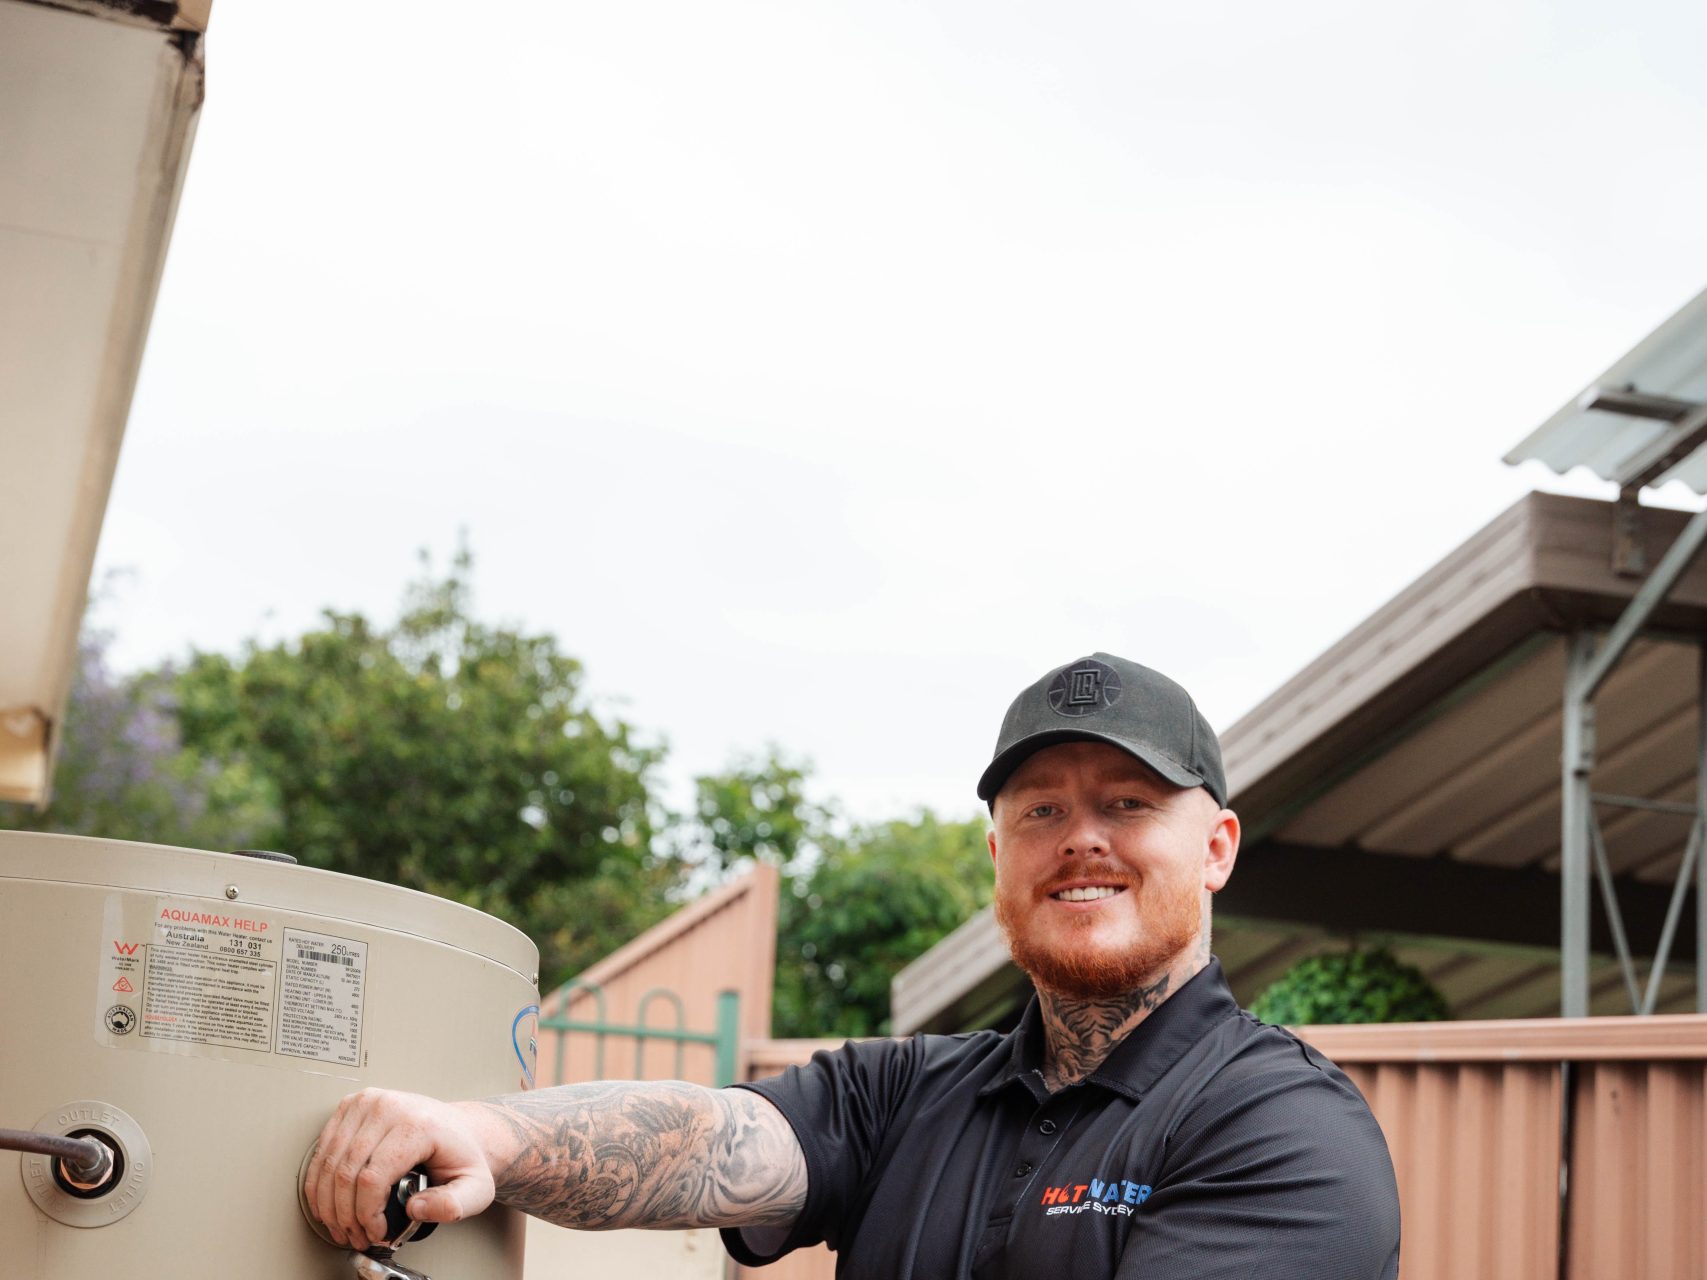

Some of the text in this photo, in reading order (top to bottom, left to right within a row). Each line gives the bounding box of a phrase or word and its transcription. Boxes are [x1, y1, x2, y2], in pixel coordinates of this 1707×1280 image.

[160, 908, 268, 932] AQUAMAX HELP
[174, 924, 196, 932] problems
[166, 931, 262, 950] Australia 131 031
[182, 940, 208, 950] Zealand
[220, 946, 235, 954] 0800
[237, 947, 248, 955] 657
[331, 943, 360, 958] 250 LITRES
[107, 1007, 133, 1021] AUSTRALIAN
[58, 1110, 120, 1126] OUTLET
[110, 1161, 144, 1214] OUTLET
[1041, 1182, 1088, 1205] HOT
